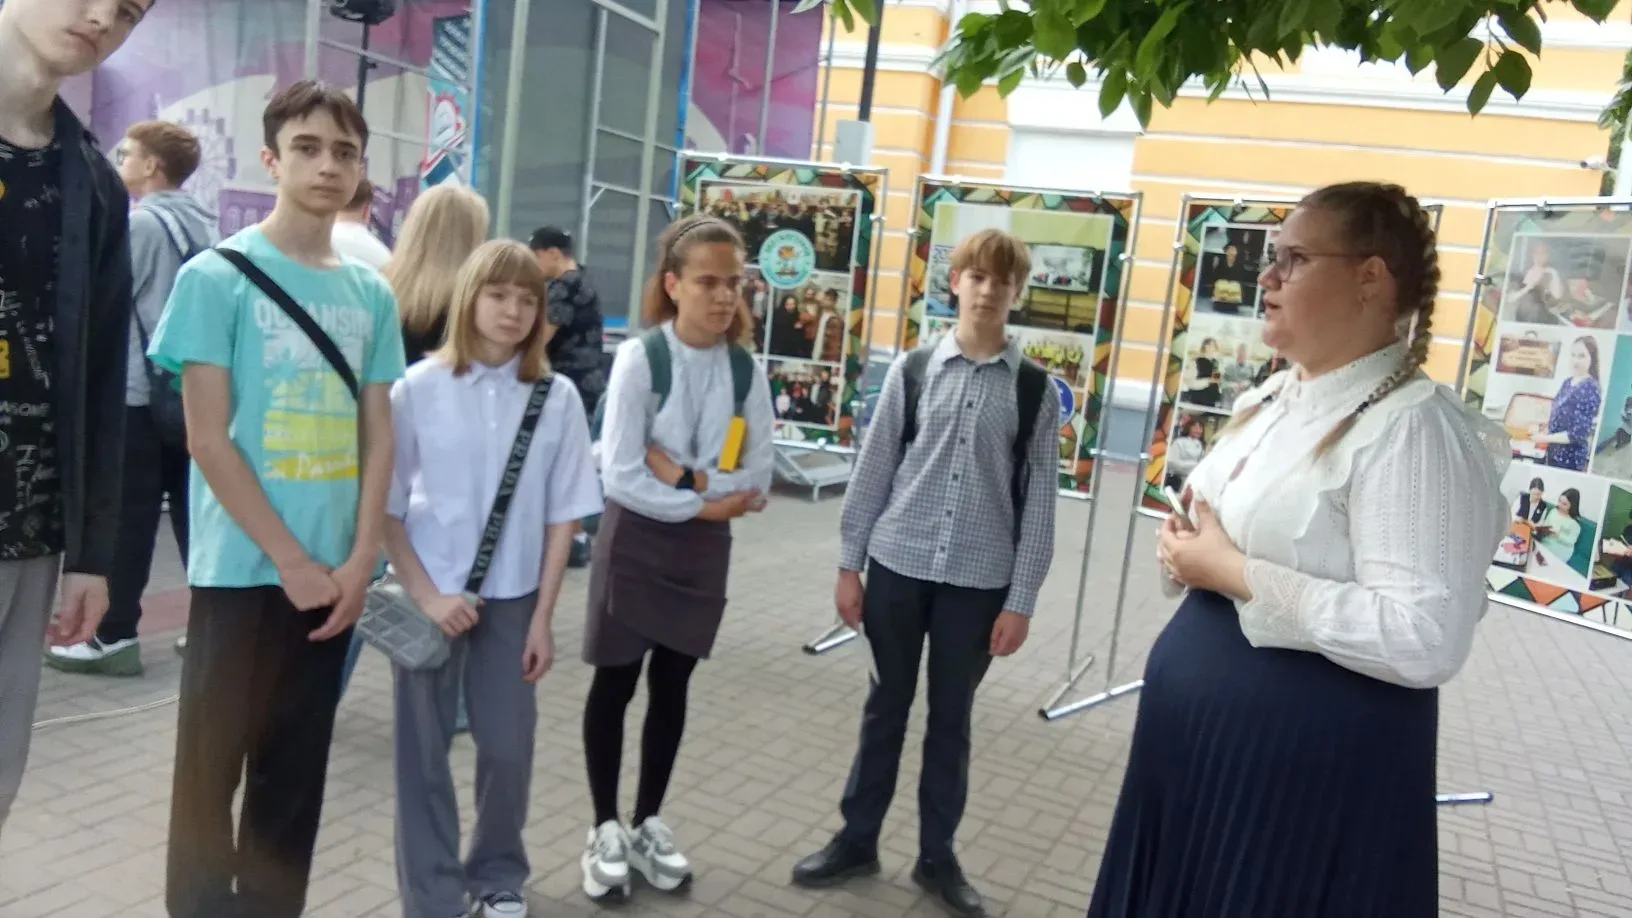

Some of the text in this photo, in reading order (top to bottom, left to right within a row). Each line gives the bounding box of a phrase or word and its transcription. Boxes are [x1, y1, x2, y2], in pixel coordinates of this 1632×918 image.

[470, 379, 551, 580] ADA PRADA PRADA
